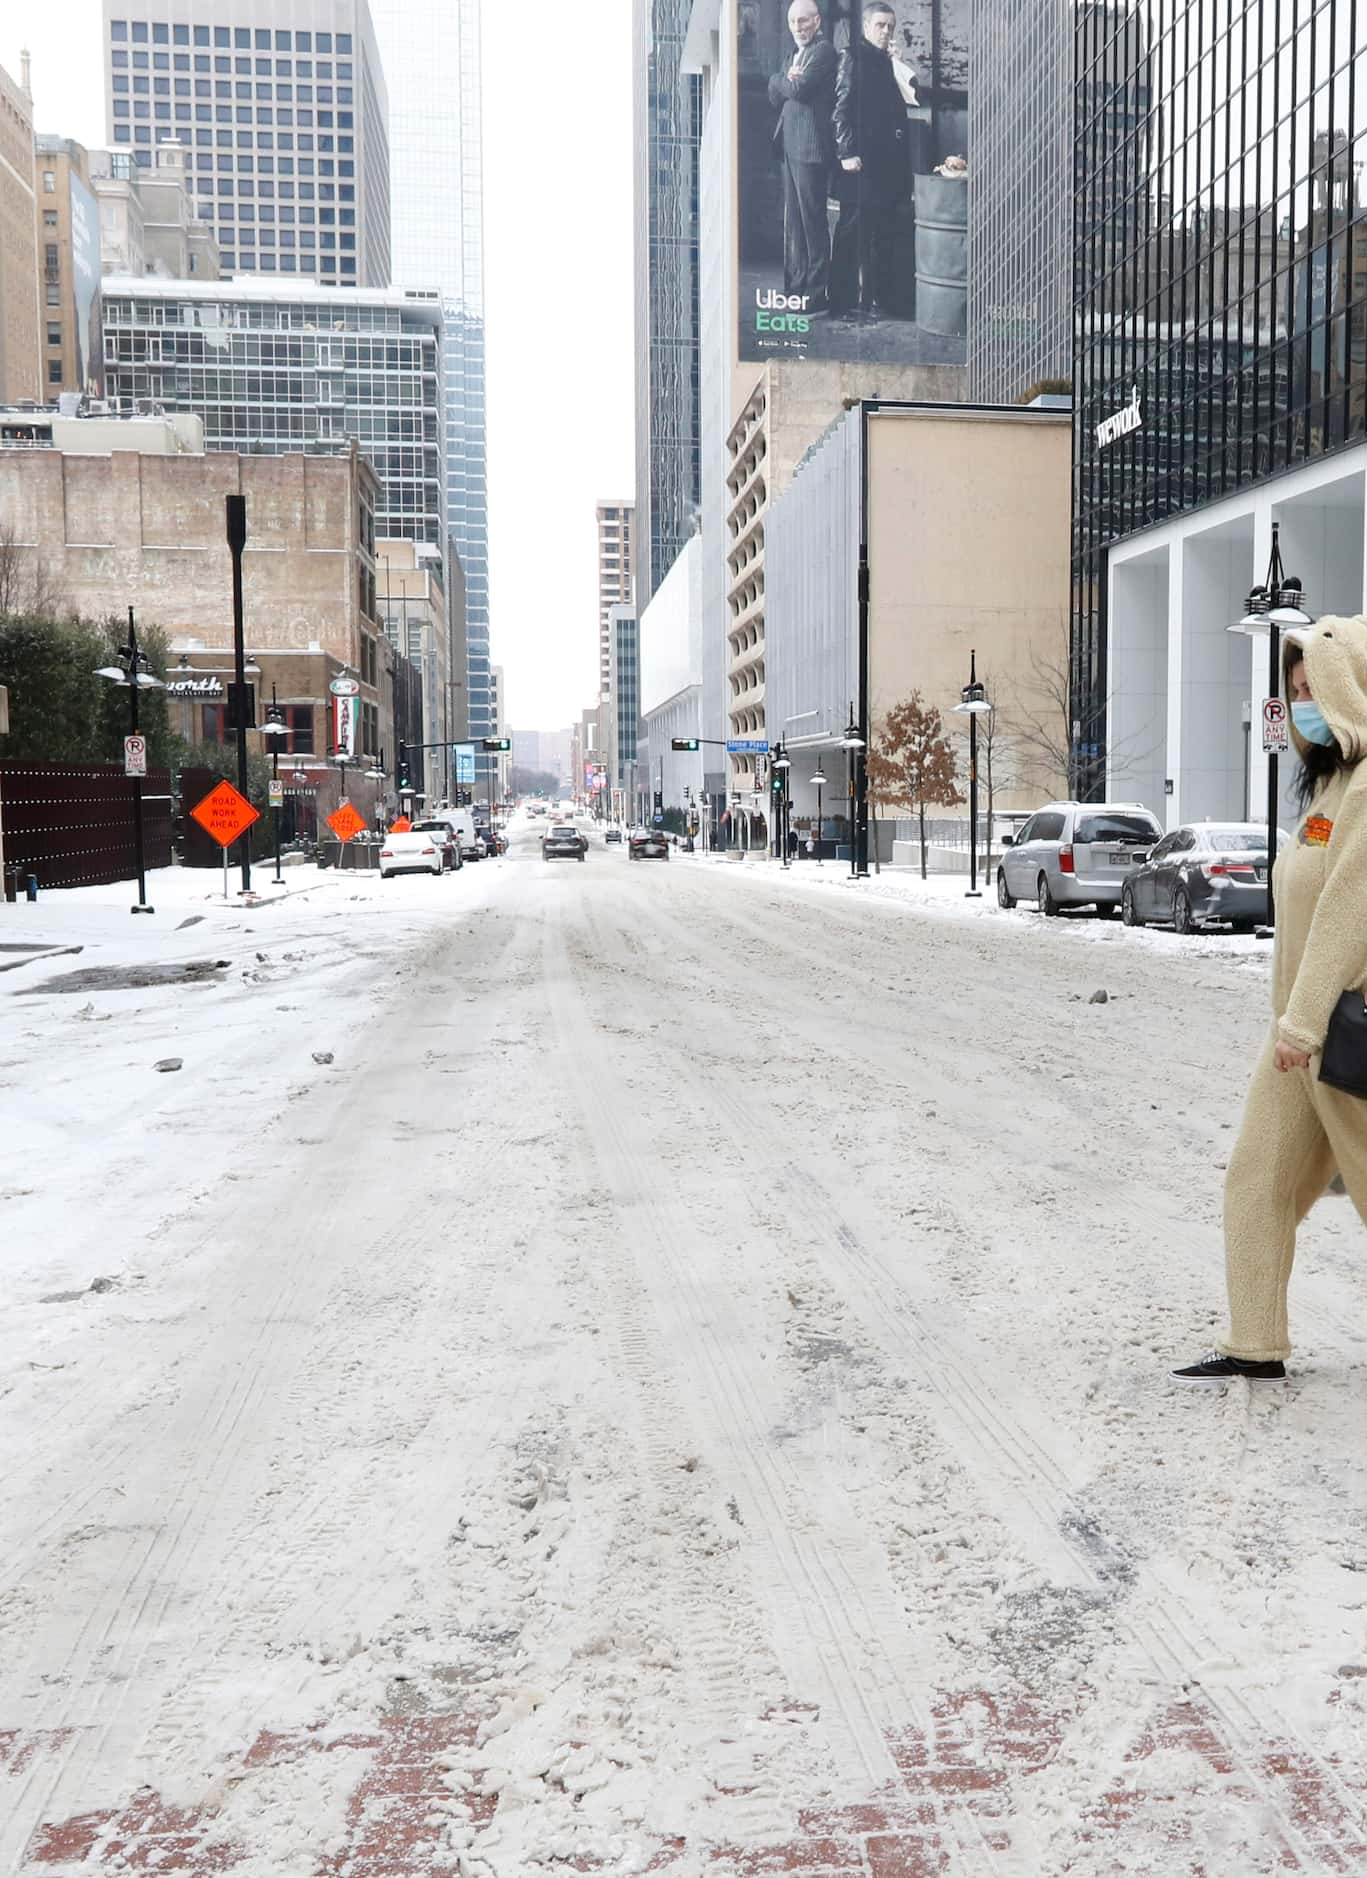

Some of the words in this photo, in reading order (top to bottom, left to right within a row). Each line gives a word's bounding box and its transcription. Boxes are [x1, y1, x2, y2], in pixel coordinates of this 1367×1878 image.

[756, 288, 810, 310] Uber
[756, 311, 810, 333] Eats
[1265, 725, 1285, 733] ANY
[1265, 733, 1285, 742] TIME
[212, 797, 237, 806] ROAD
[212, 809, 236, 817] WORK
[210, 820, 239, 829] AHEAD
